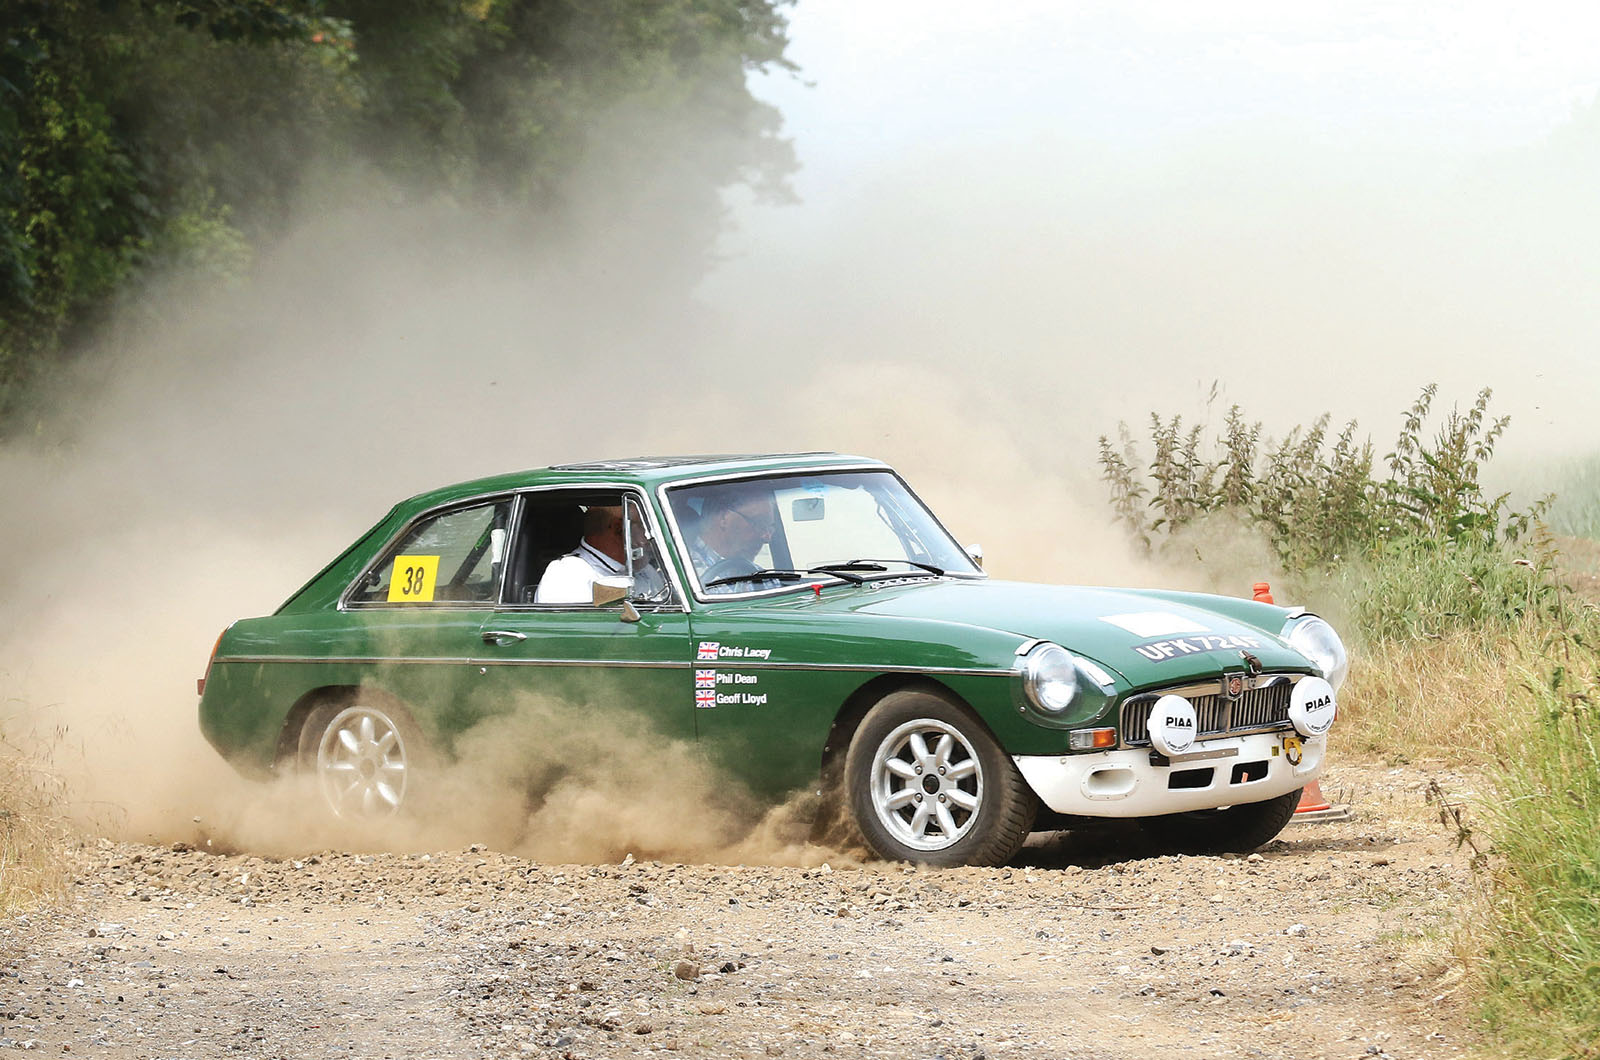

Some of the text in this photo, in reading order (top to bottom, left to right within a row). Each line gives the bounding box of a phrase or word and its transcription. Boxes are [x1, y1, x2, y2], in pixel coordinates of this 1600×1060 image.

[402, 566, 425, 595] 38
[719, 646, 771, 660] Chris Lacey
[1135, 639, 1201, 660] UFK
[716, 673, 757, 684] Phil Dean
[716, 693, 767, 706] Geoff Lloyd
[1305, 695, 1331, 712] PIAA
[1166, 716, 1192, 727] PIAA
